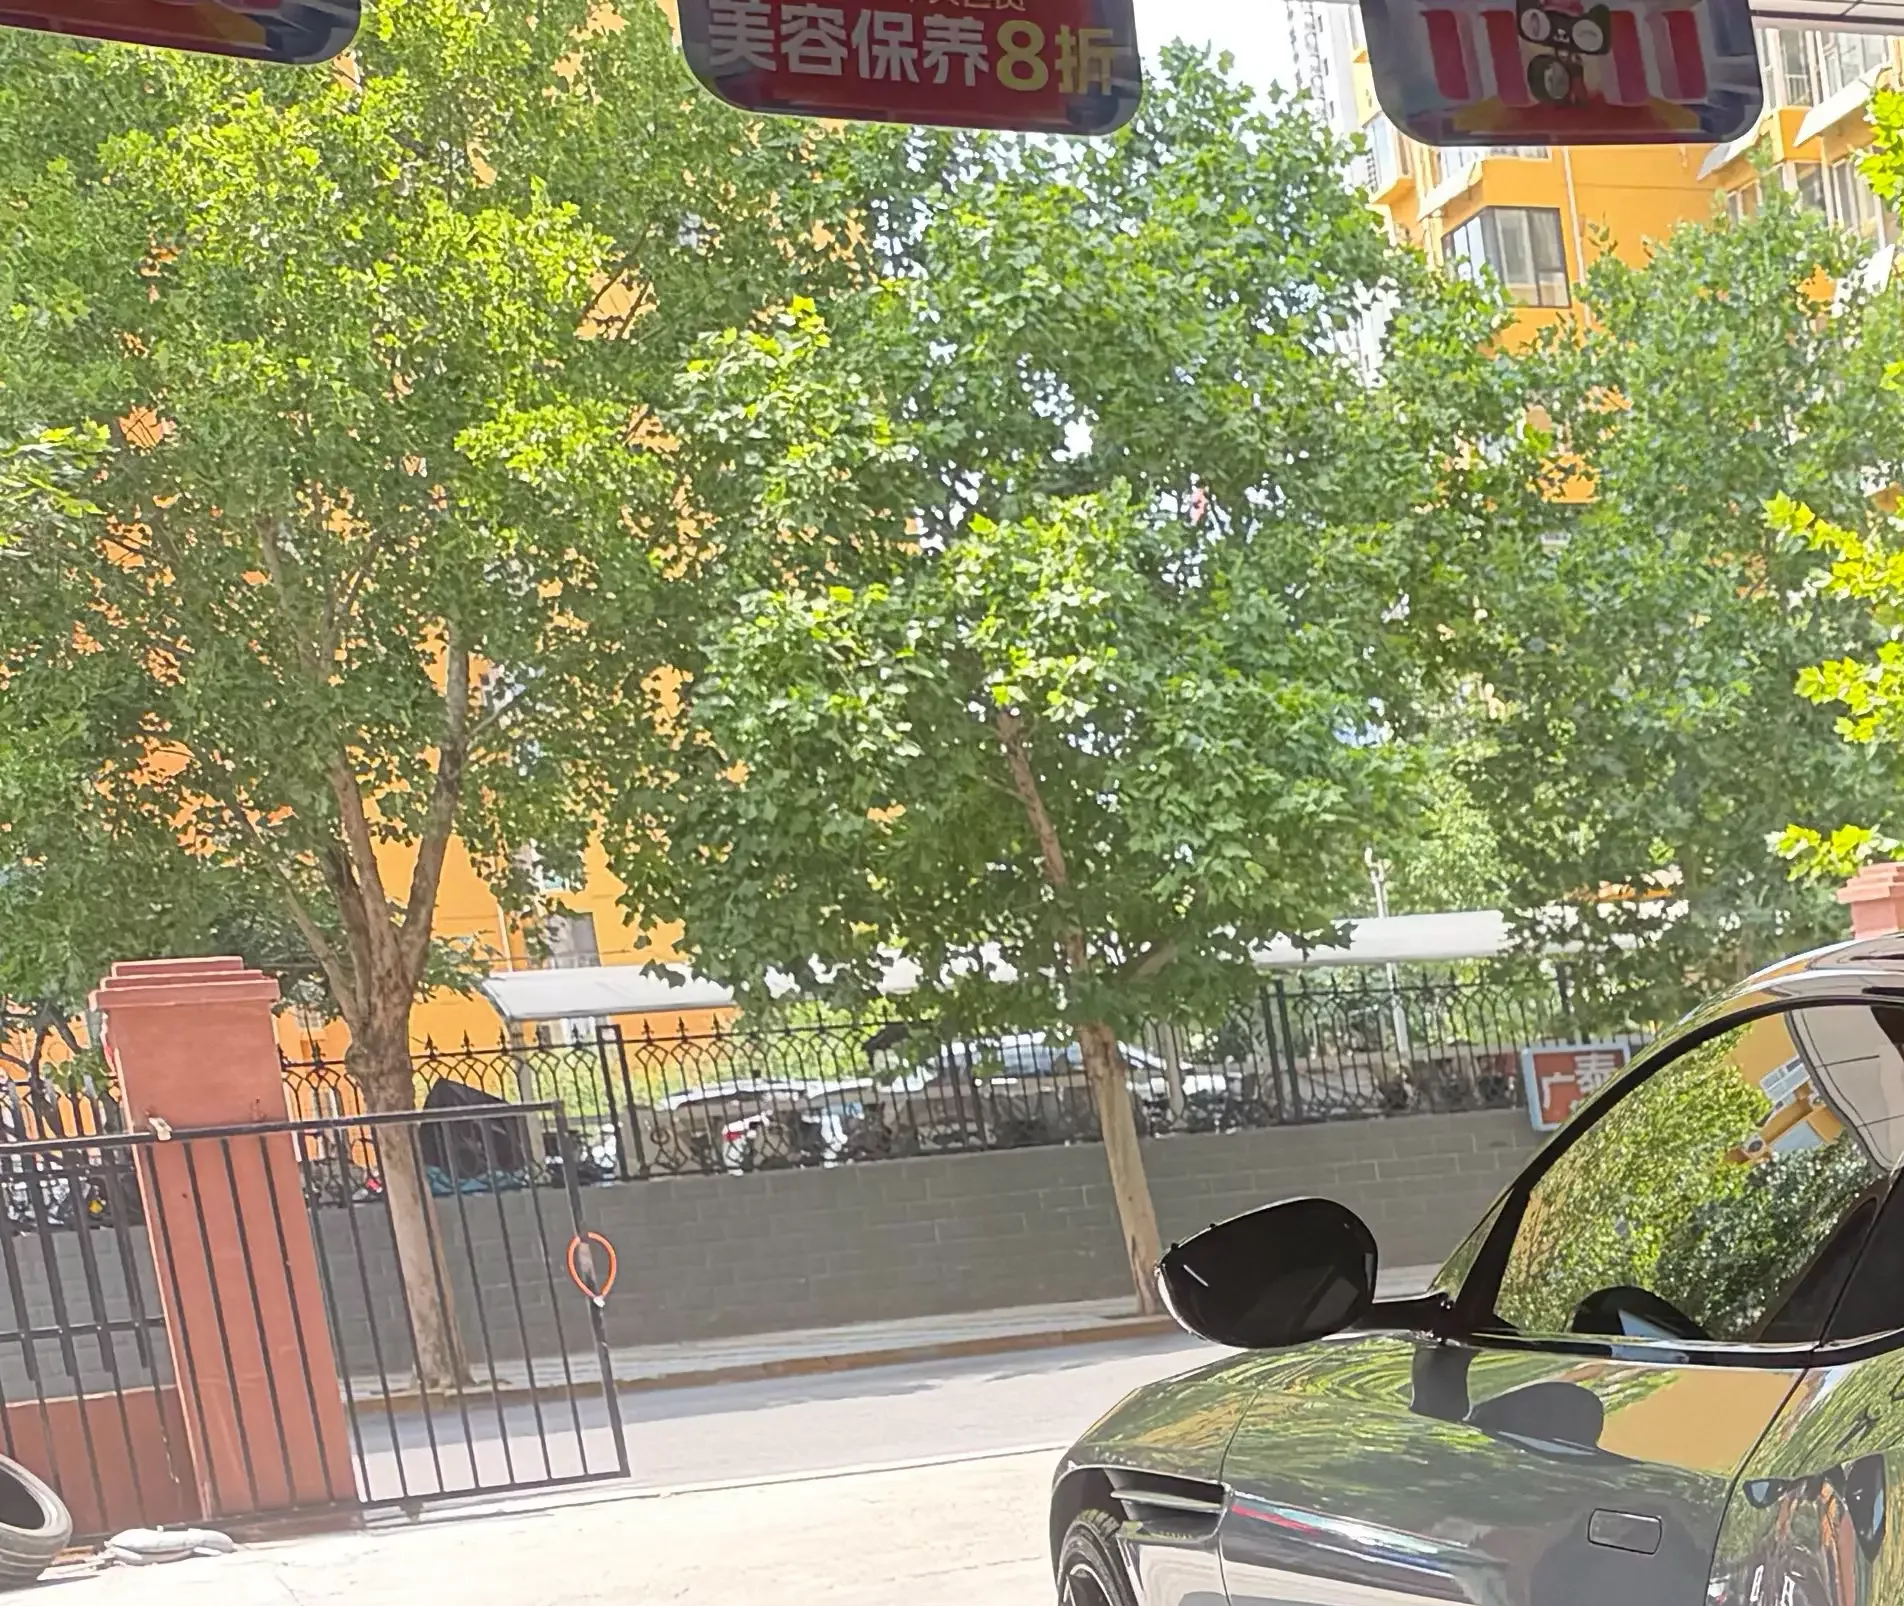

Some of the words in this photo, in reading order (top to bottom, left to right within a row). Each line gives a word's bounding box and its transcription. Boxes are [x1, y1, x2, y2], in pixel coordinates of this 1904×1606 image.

[707, 3, 1116, 96] 美容保养8折
